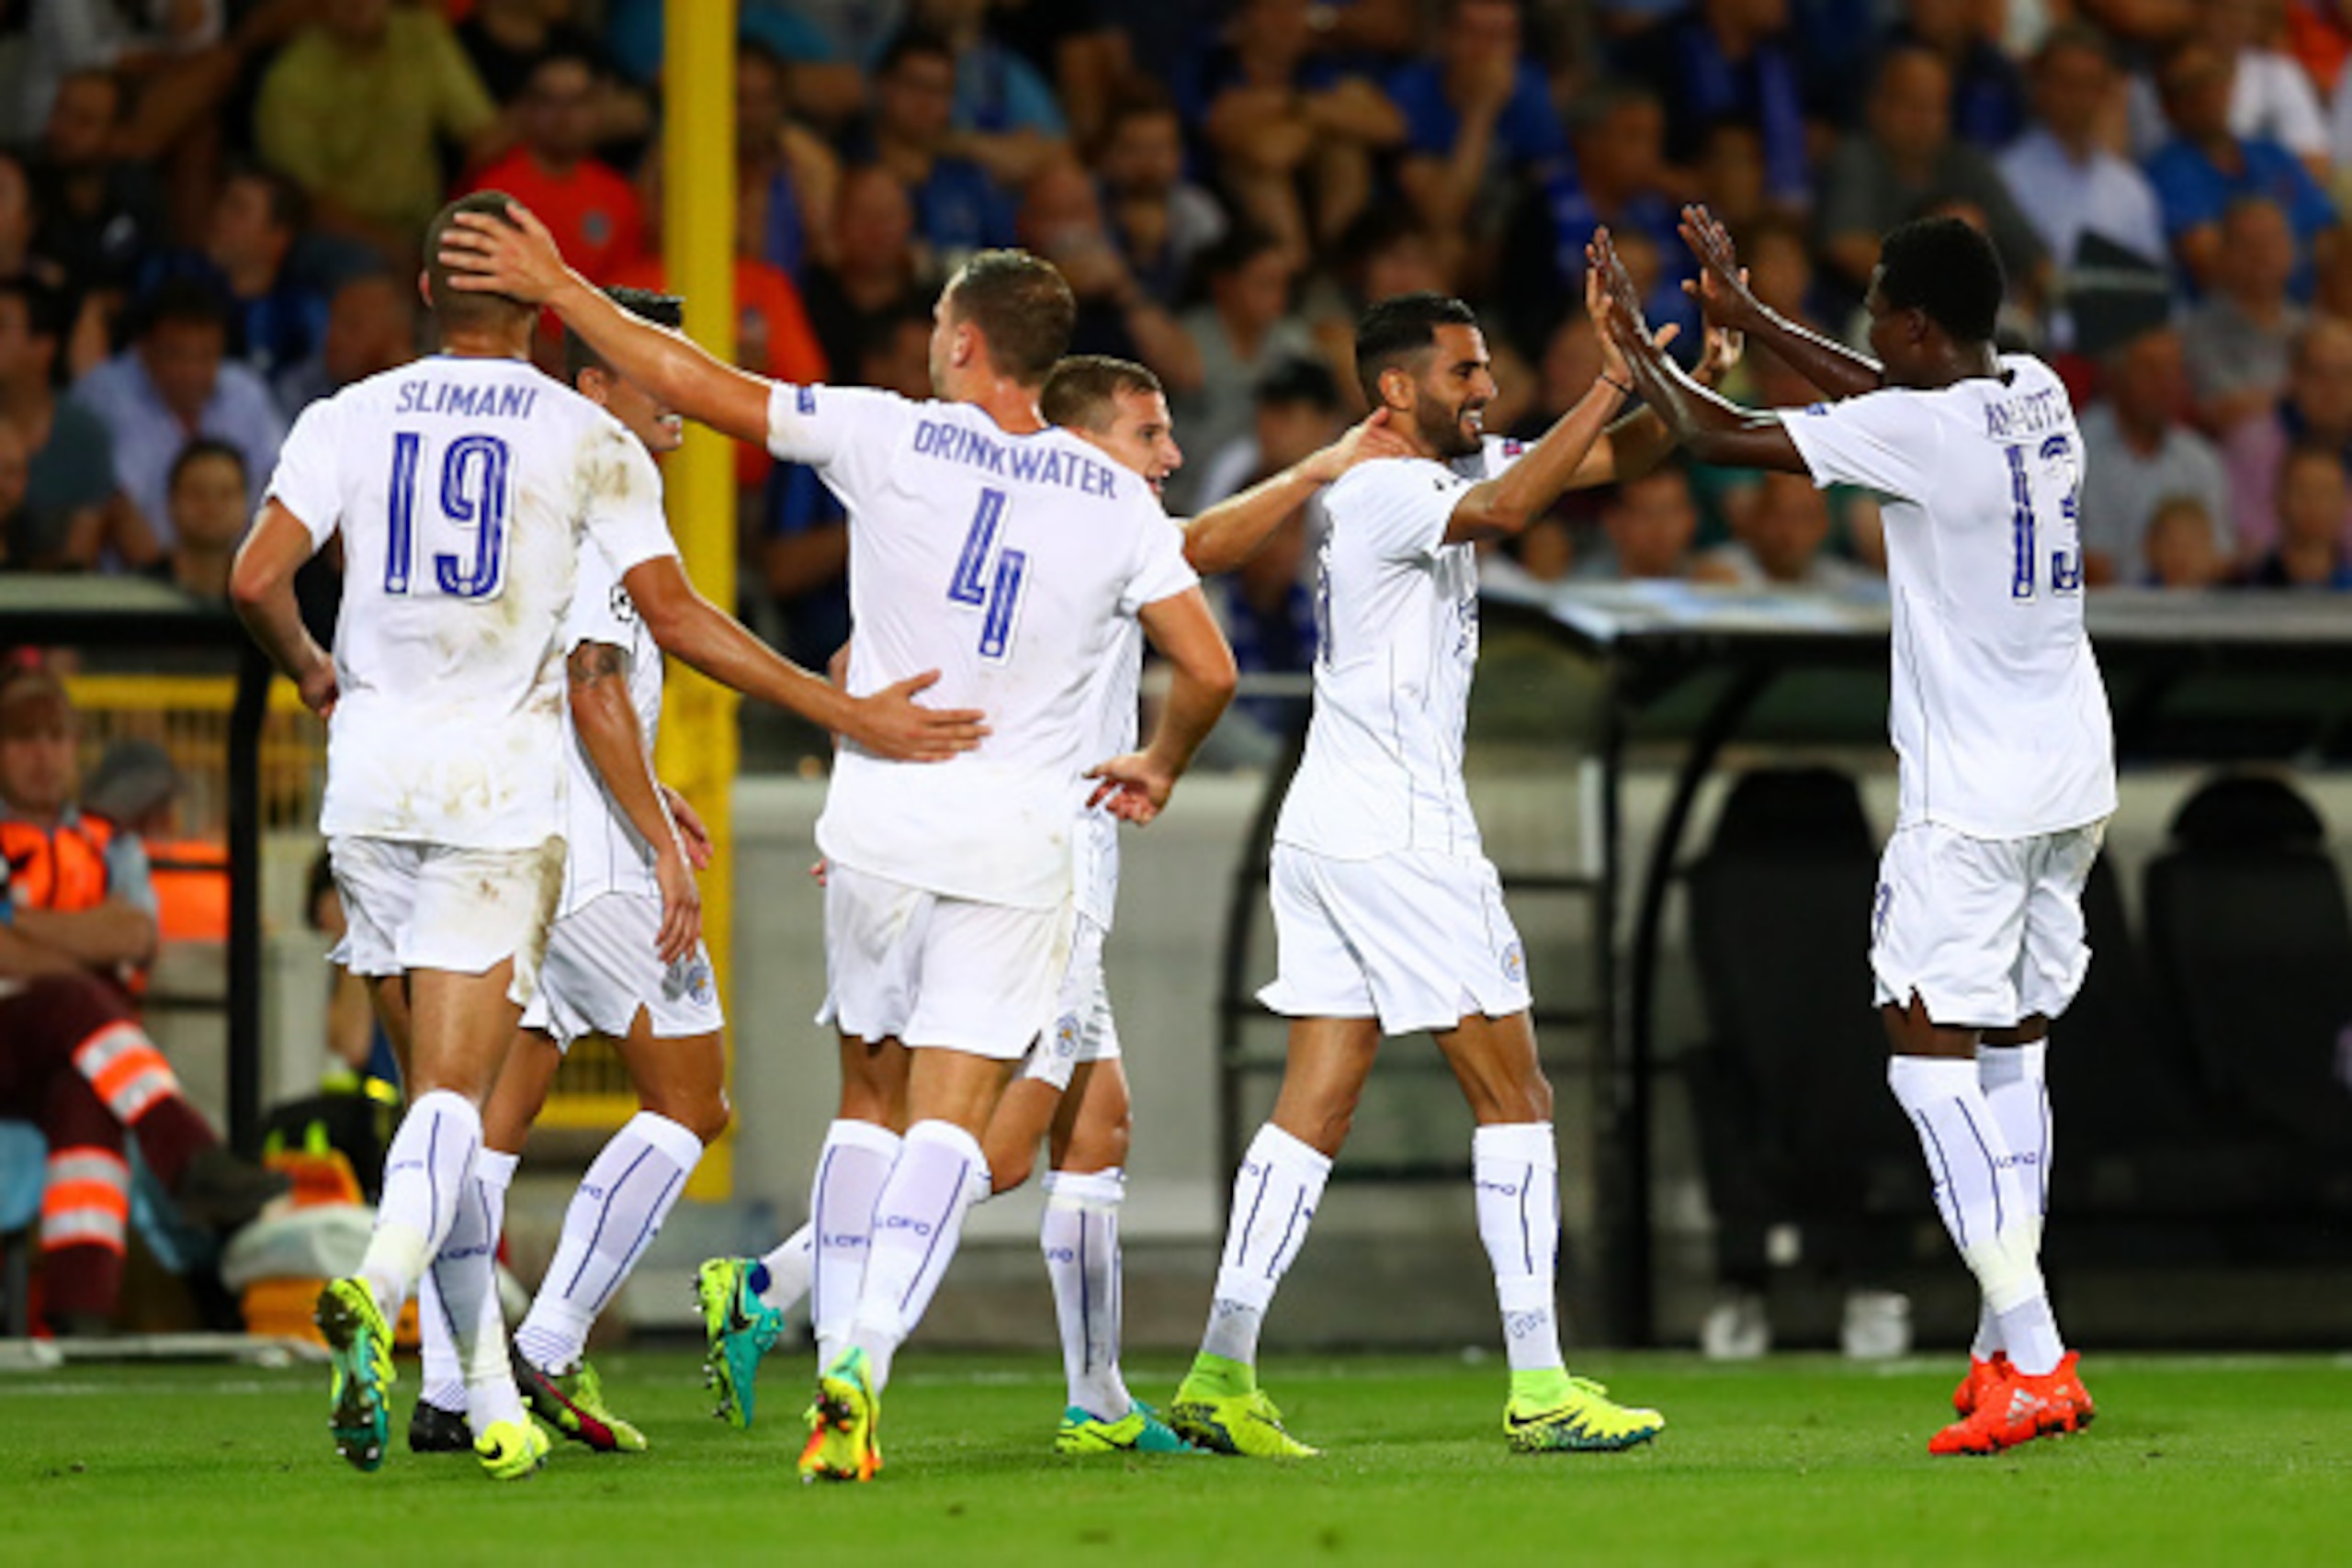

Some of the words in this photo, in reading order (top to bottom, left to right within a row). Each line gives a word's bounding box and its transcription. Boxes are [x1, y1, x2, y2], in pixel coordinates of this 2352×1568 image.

[396, 381, 539, 419] SLIMANI
[913, 419, 1117, 500] DRINKWATER
[384, 432, 510, 598] 19
[947, 487, 1026, 658] 4
